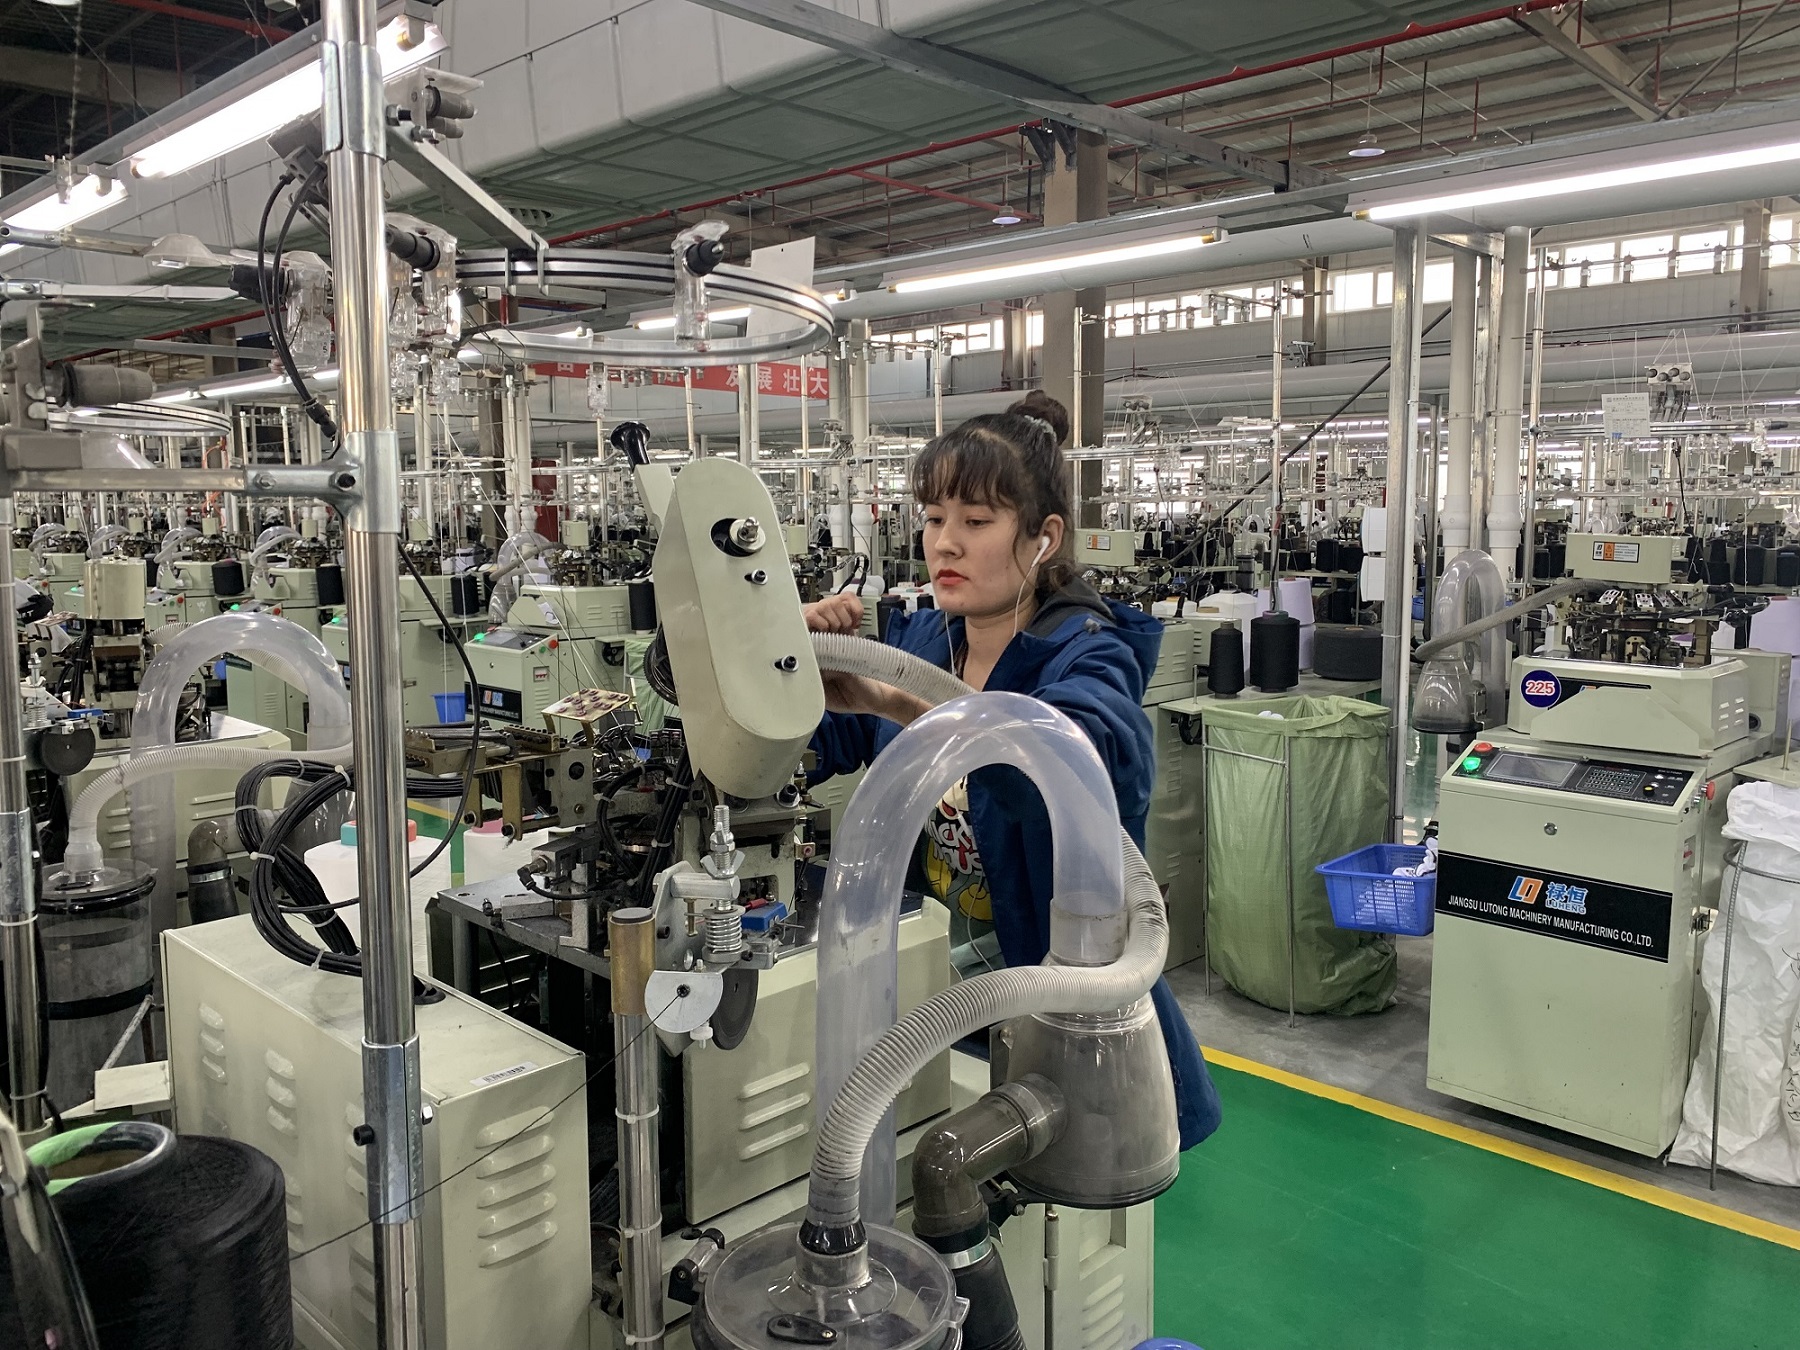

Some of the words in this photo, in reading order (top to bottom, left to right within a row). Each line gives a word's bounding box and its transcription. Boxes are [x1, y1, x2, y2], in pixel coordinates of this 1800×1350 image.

[726, 365, 828, 395] 发展壮大
[1526, 680, 1555, 696] 225
[1546, 882, 1588, 904] 禄恒
[1545, 900, 1587, 915] LUHENG
[1448, 894, 1478, 910] JIANGSU
[1479, 902, 1508, 916] LUTONG
[1509, 907, 1552, 926] MACHINERY
[1553, 916, 1619, 940] MANUFACTURING
[1620, 931, 1654, 947] CO.,LTD.
